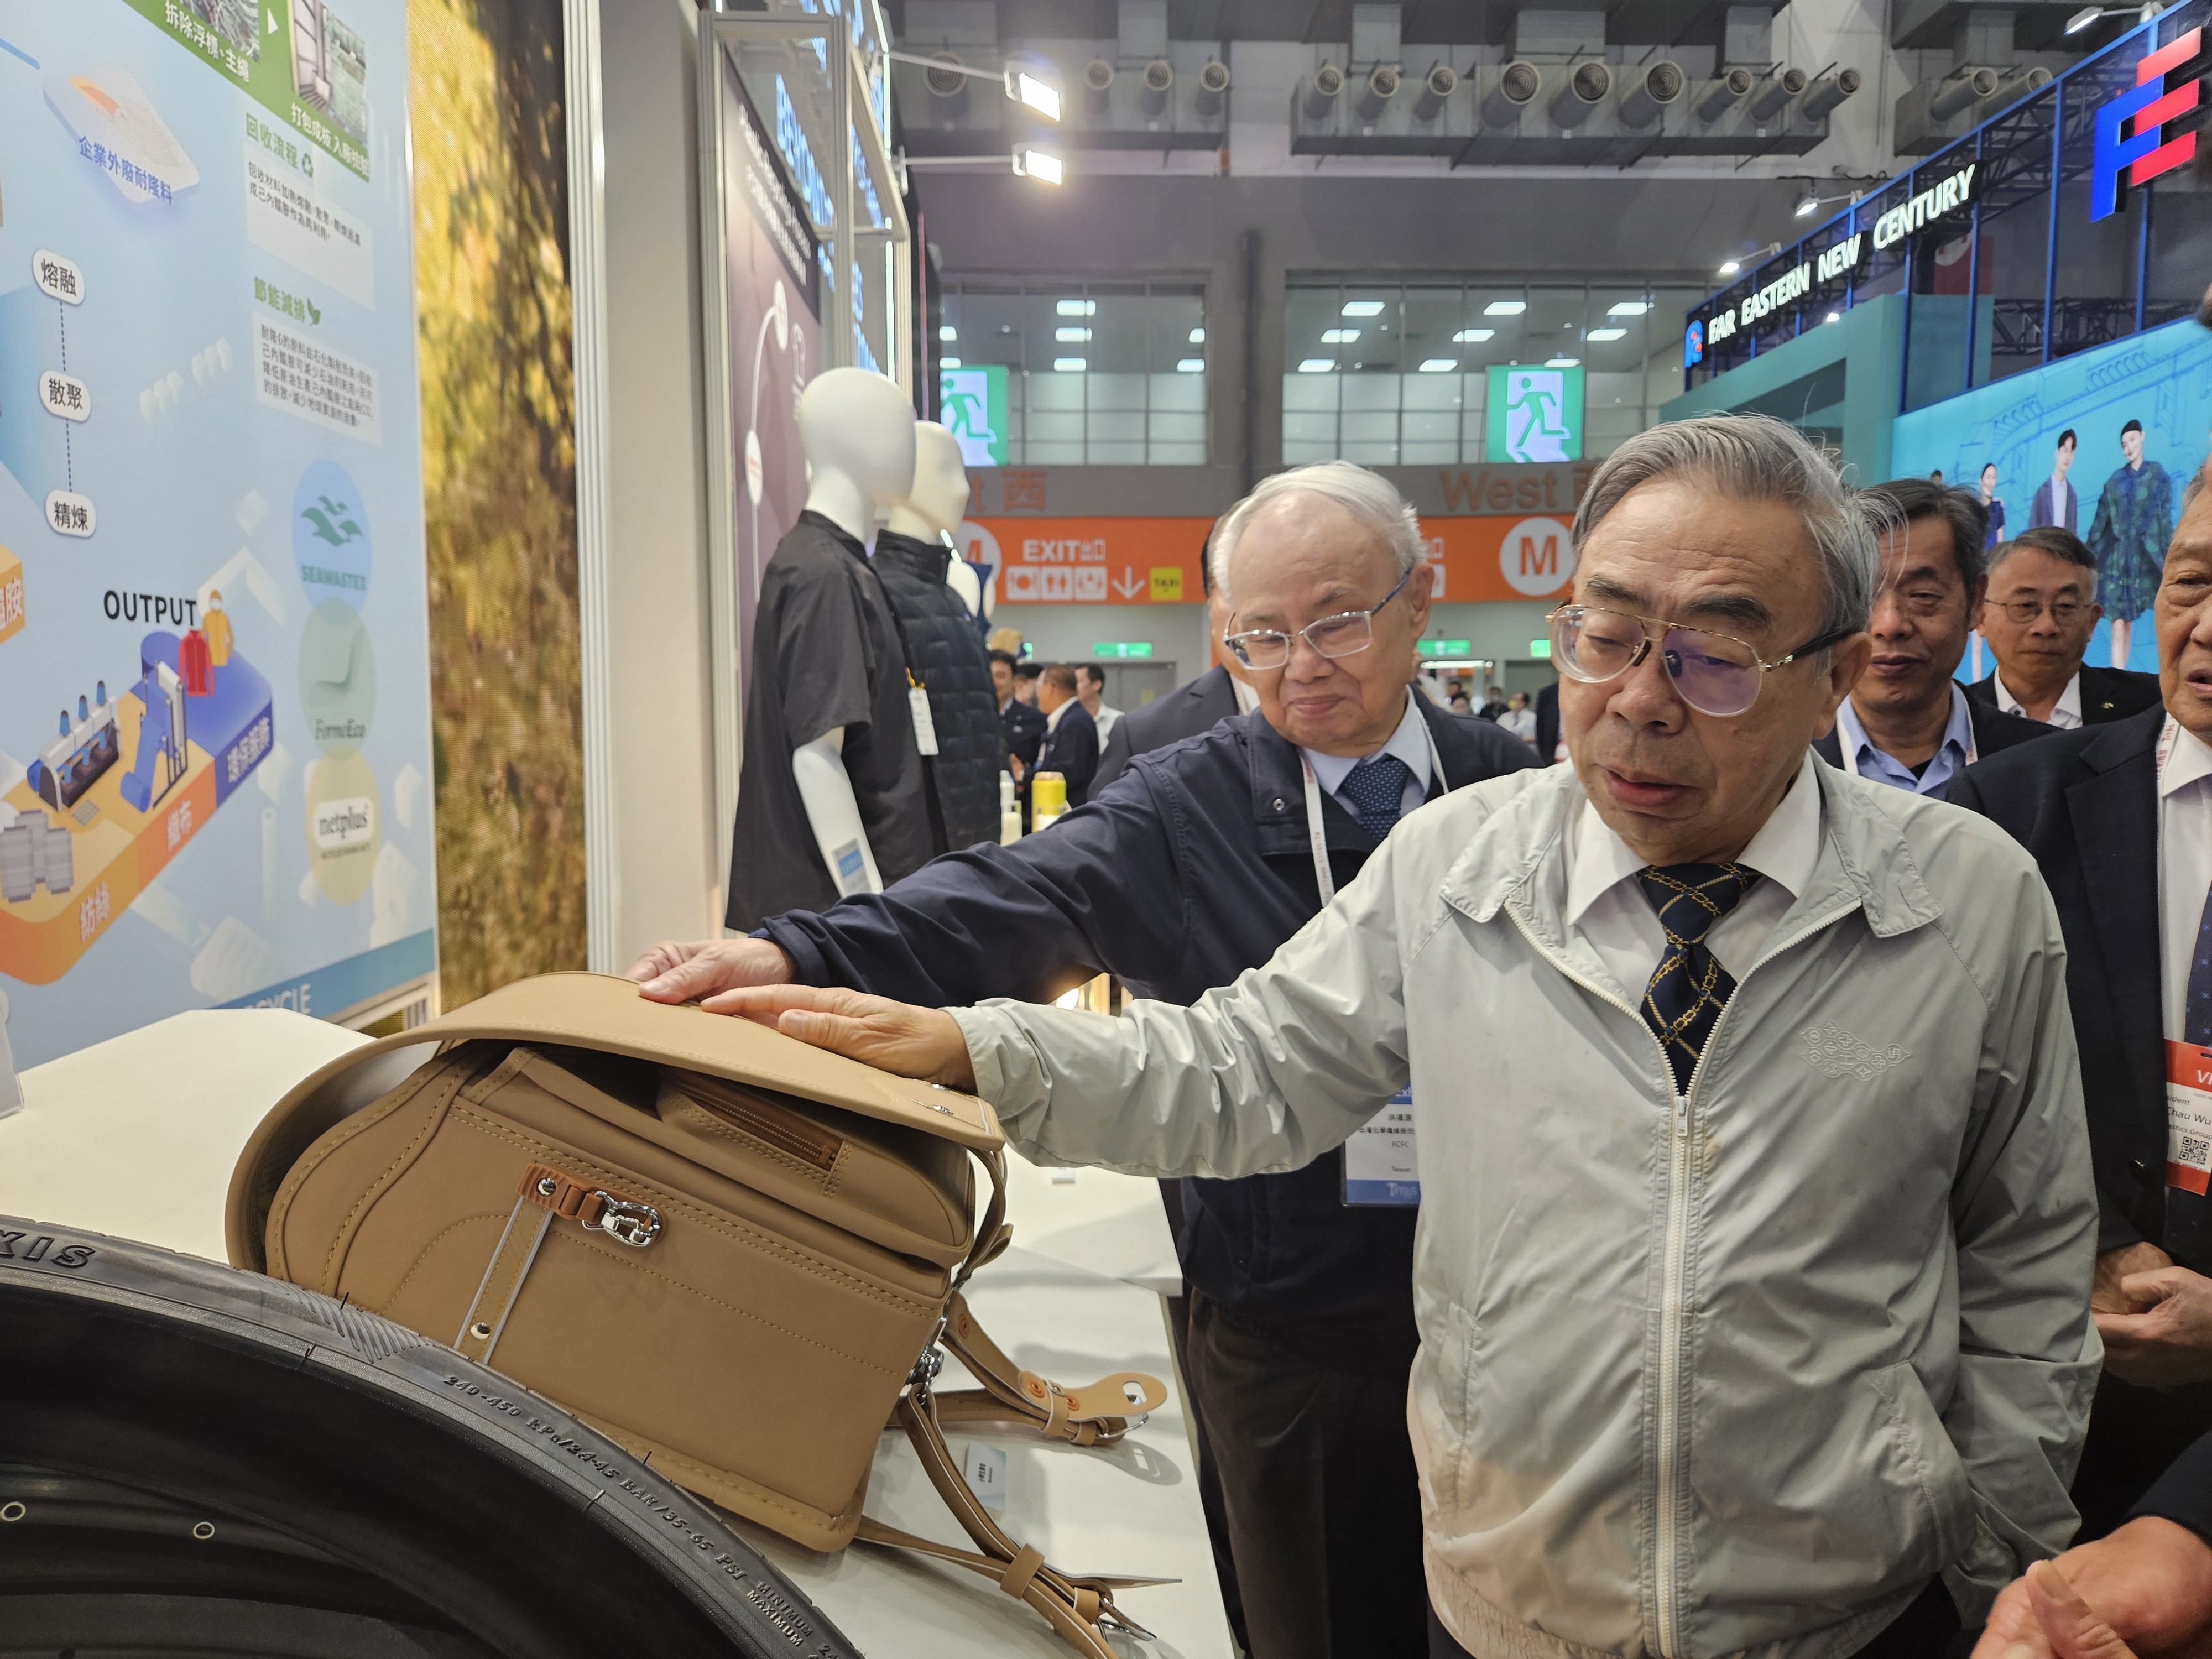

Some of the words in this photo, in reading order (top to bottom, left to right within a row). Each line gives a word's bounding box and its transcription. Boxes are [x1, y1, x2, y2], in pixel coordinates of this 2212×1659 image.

[247, 113, 298, 169] 回收流程
[1708, 309, 1736, 345] FAR
[1741, 261, 1811, 326] EASTERN
[1818, 233, 1862, 283] NEW
[1872, 164, 1975, 251] CENTURY
[41, 258, 77, 297] 熔融
[48, 377, 83, 411] 散聚
[1003, 470, 1047, 511] 西
[1441, 470, 1557, 511] West
[54, 500, 88, 531] 精煉
[1023, 539, 1080, 562] EXIT
[1520, 535, 1557, 576] M
[103, 590, 197, 626] OUTPUT
[2190, 1129, 2212, 1139] Group
[2194, 1113, 2211, 1125] Wu
[442, 1375, 523, 1417] 240-450
[714, 1552, 748, 1580] PSI
[747, 1589, 804, 1647] MAXIMUM
[757, 1581, 813, 1637] MINIMUM
